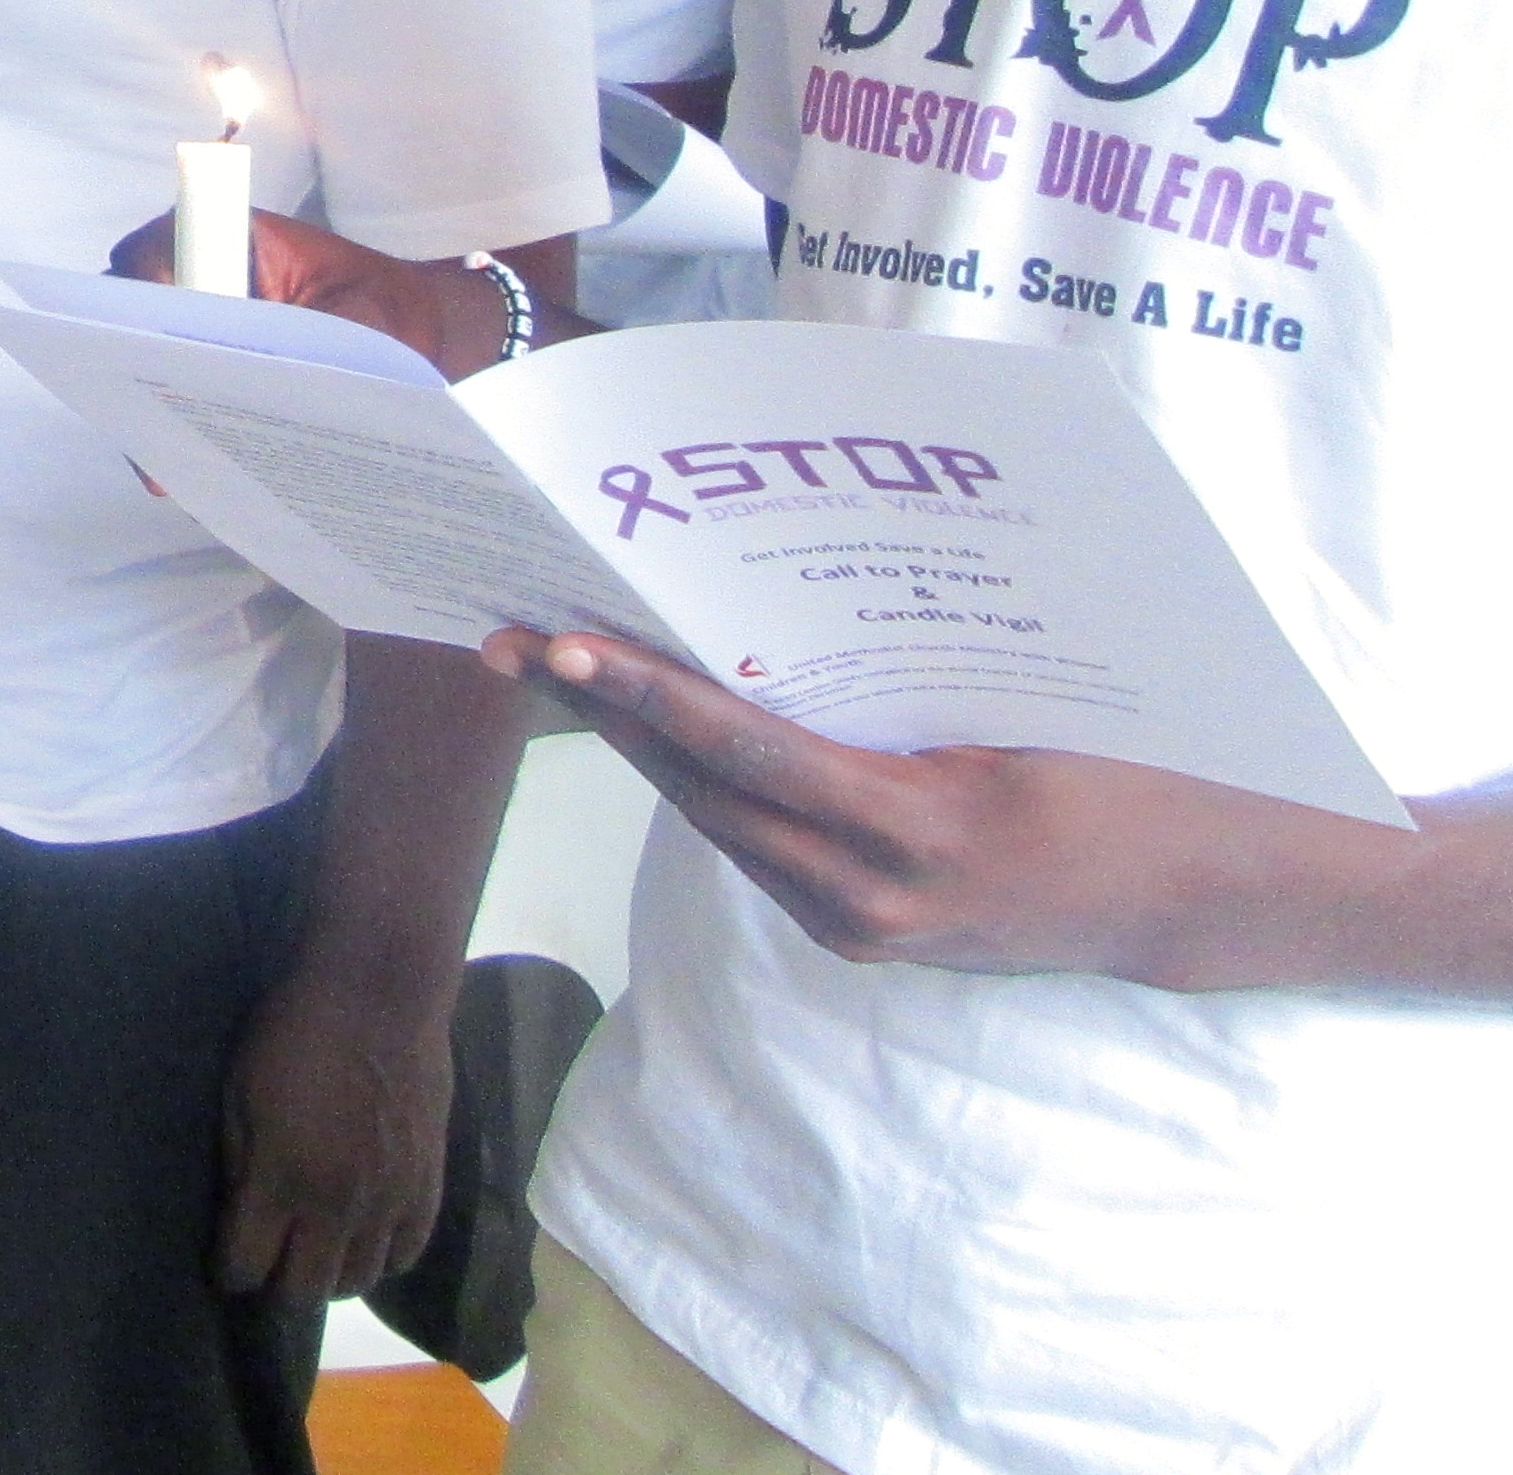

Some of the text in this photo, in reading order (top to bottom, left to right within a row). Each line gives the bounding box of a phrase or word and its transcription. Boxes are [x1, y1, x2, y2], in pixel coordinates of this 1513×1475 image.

[800, 65, 1336, 272] DOMESTIC VIOLENCE
[833, 230, 995, 300] Involved,
[1017, 256, 1117, 317] Save
[1130, 279, 1168, 328] A
[1191, 288, 1305, 353] Life
[660, 436, 1002, 500] STOP
[702, 492, 868, 522] DOMESTIC
[740, 548, 775, 564] Get
[800, 563, 1013, 588] Call to Prayer
[909, 585, 940, 601] &
[856, 608, 1046, 633] Candle Vigil
